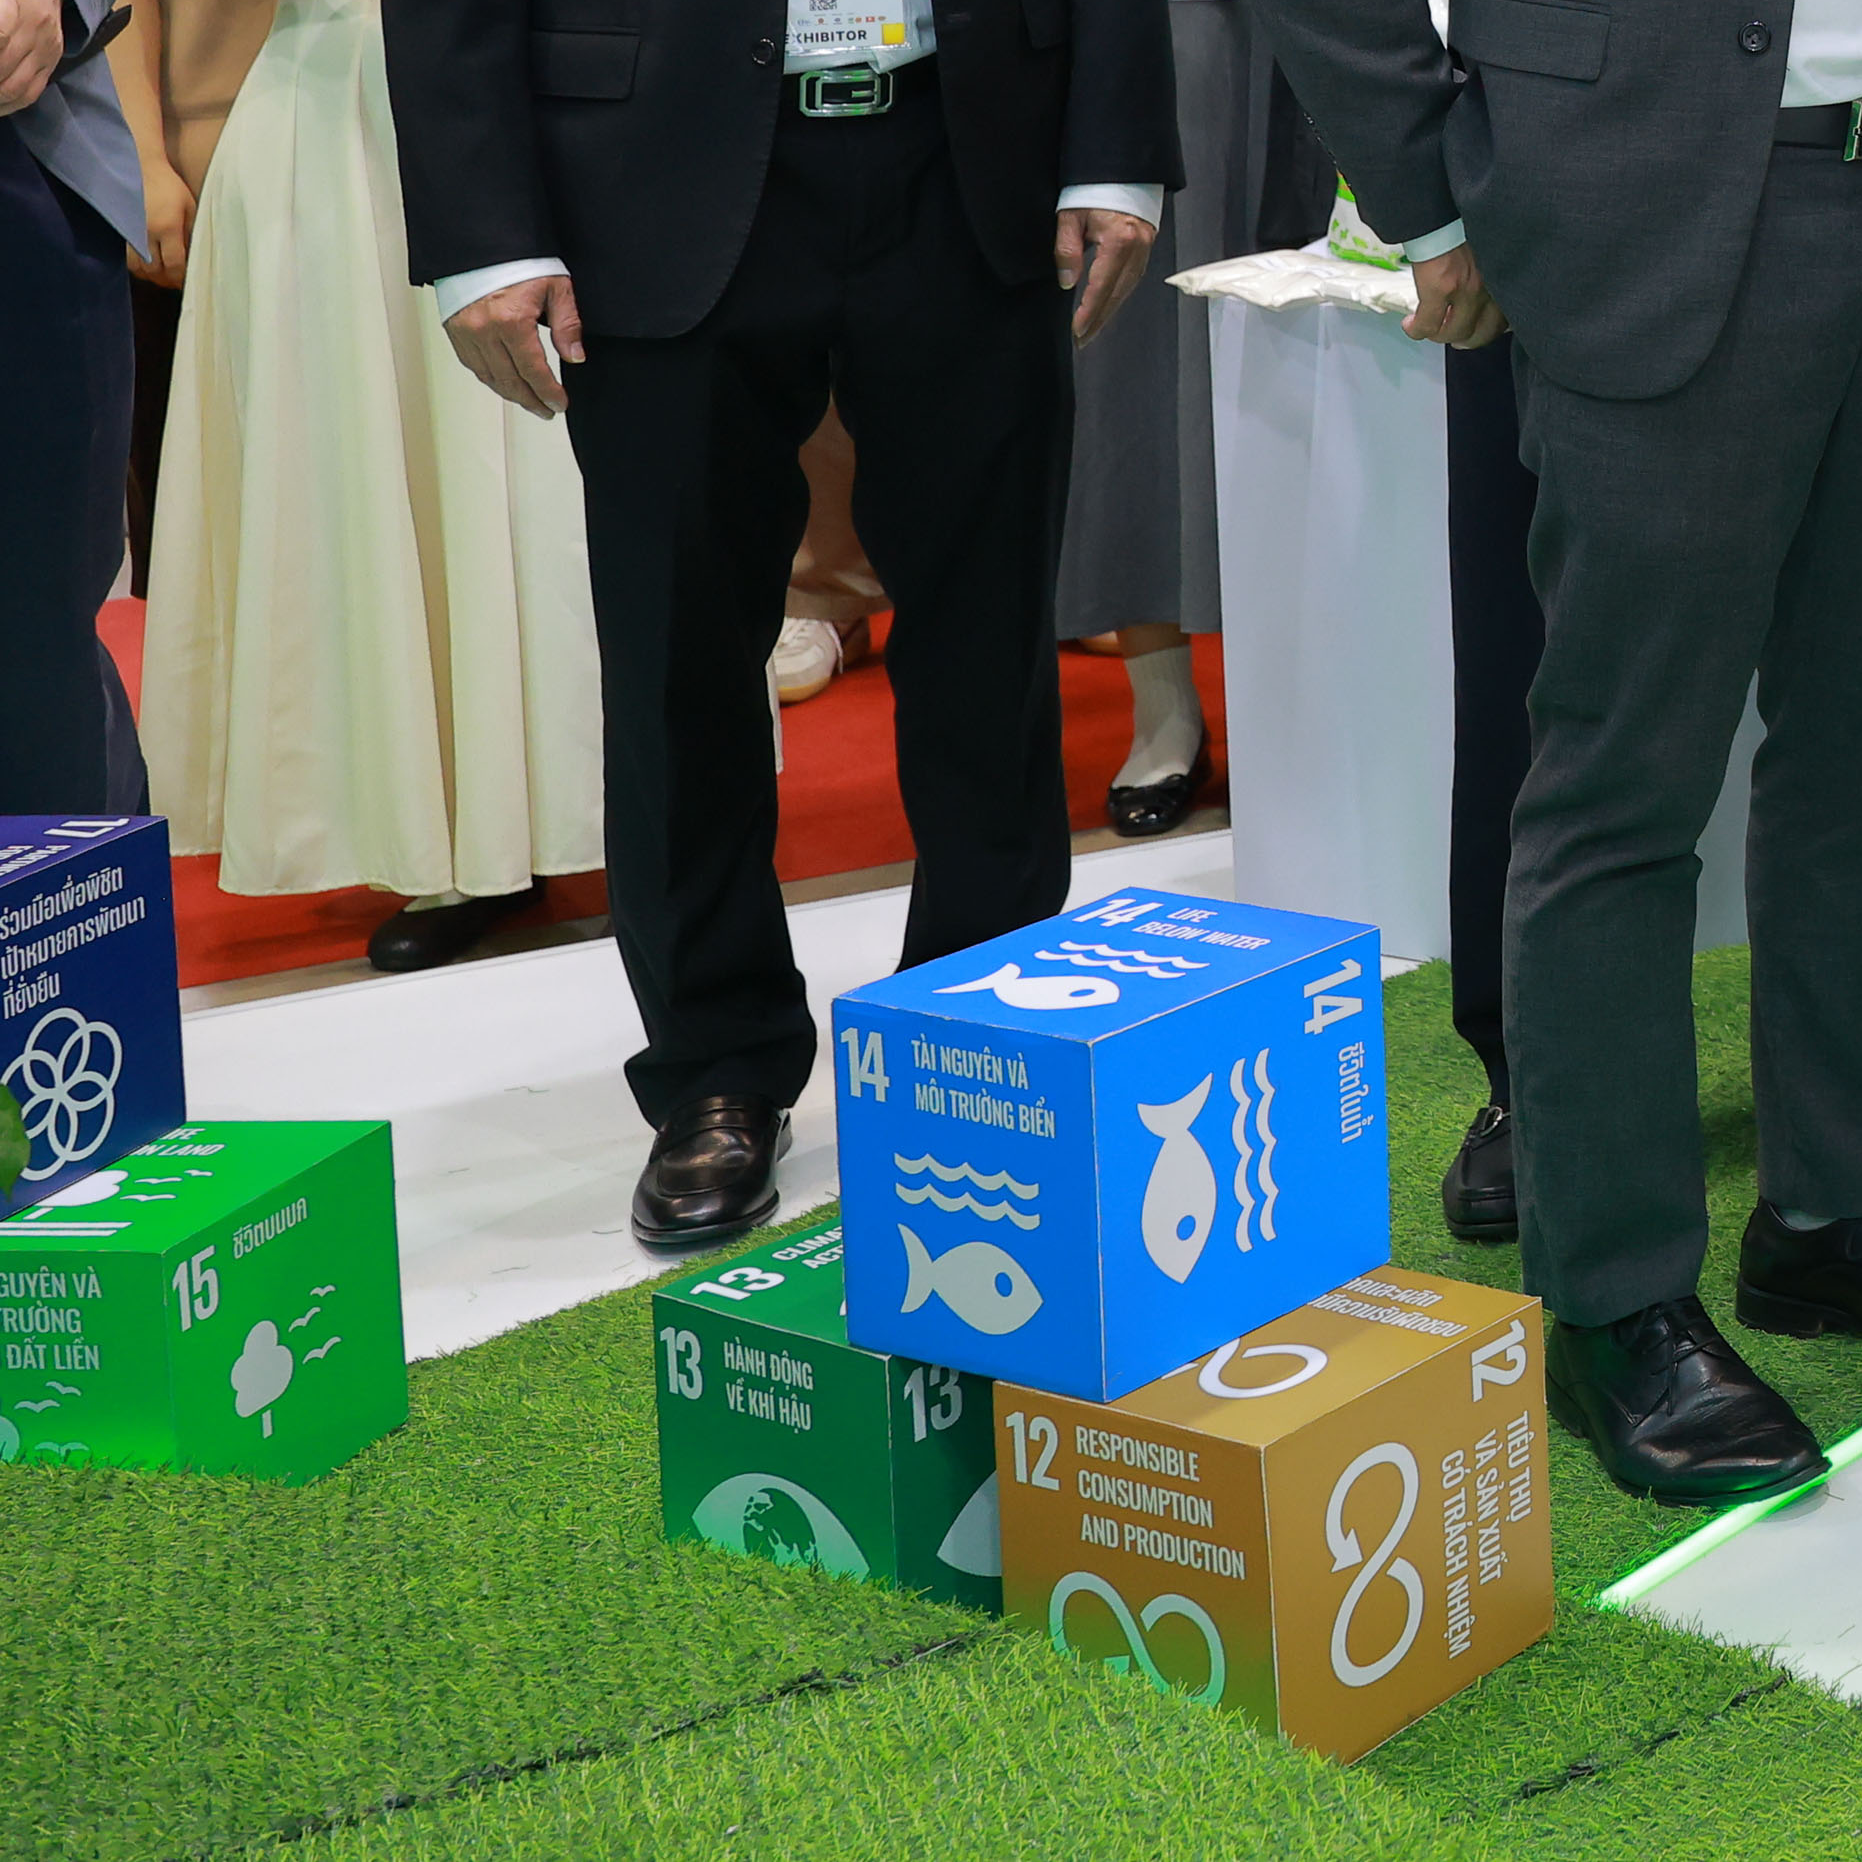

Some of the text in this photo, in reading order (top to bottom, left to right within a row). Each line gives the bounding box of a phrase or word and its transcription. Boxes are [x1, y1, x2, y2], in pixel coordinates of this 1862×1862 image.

[1073, 898, 1219, 928] 14 LIFE
[1133, 920, 1273, 951] BELOW WATER
[1302, 958, 1364, 1035] 14
[840, 1027, 1029, 1103] 14 TÀI NGUYÊN VÀ
[915, 1077, 1056, 1139] MÔI TRƯỜNG BIỂN
[161, 1143, 226, 1158] LAND
[232, 1196, 308, 1262] ชีวิตบนบก
[73, 1266, 102, 1299] VÀ
[173, 1246, 219, 1332] 15
[689, 1266, 786, 1301] 13
[6, 1332, 101, 1371] ĐẤT LIỀN
[660, 1326, 814, 1400] 13 HÀNH ĐỘNG
[1471, 1319, 1528, 1403] 12
[726, 1377, 812, 1434] VỀ KHÍ HẬU
[903, 1365, 963, 1442] 13
[1004, 1411, 1200, 1491] 12 RESPONSIBLE
[1506, 1410, 1535, 1524] TIÊU THỤ
[1077, 1469, 1213, 1529] CONSUMPTION
[1476, 1428, 1509, 1586] VÀ SẢN XUẤT
[1081, 1513, 1246, 1581] AND PRODUCTION
[1441, 1449, 1473, 1660] CÓ TRÁCH NHIỆM
